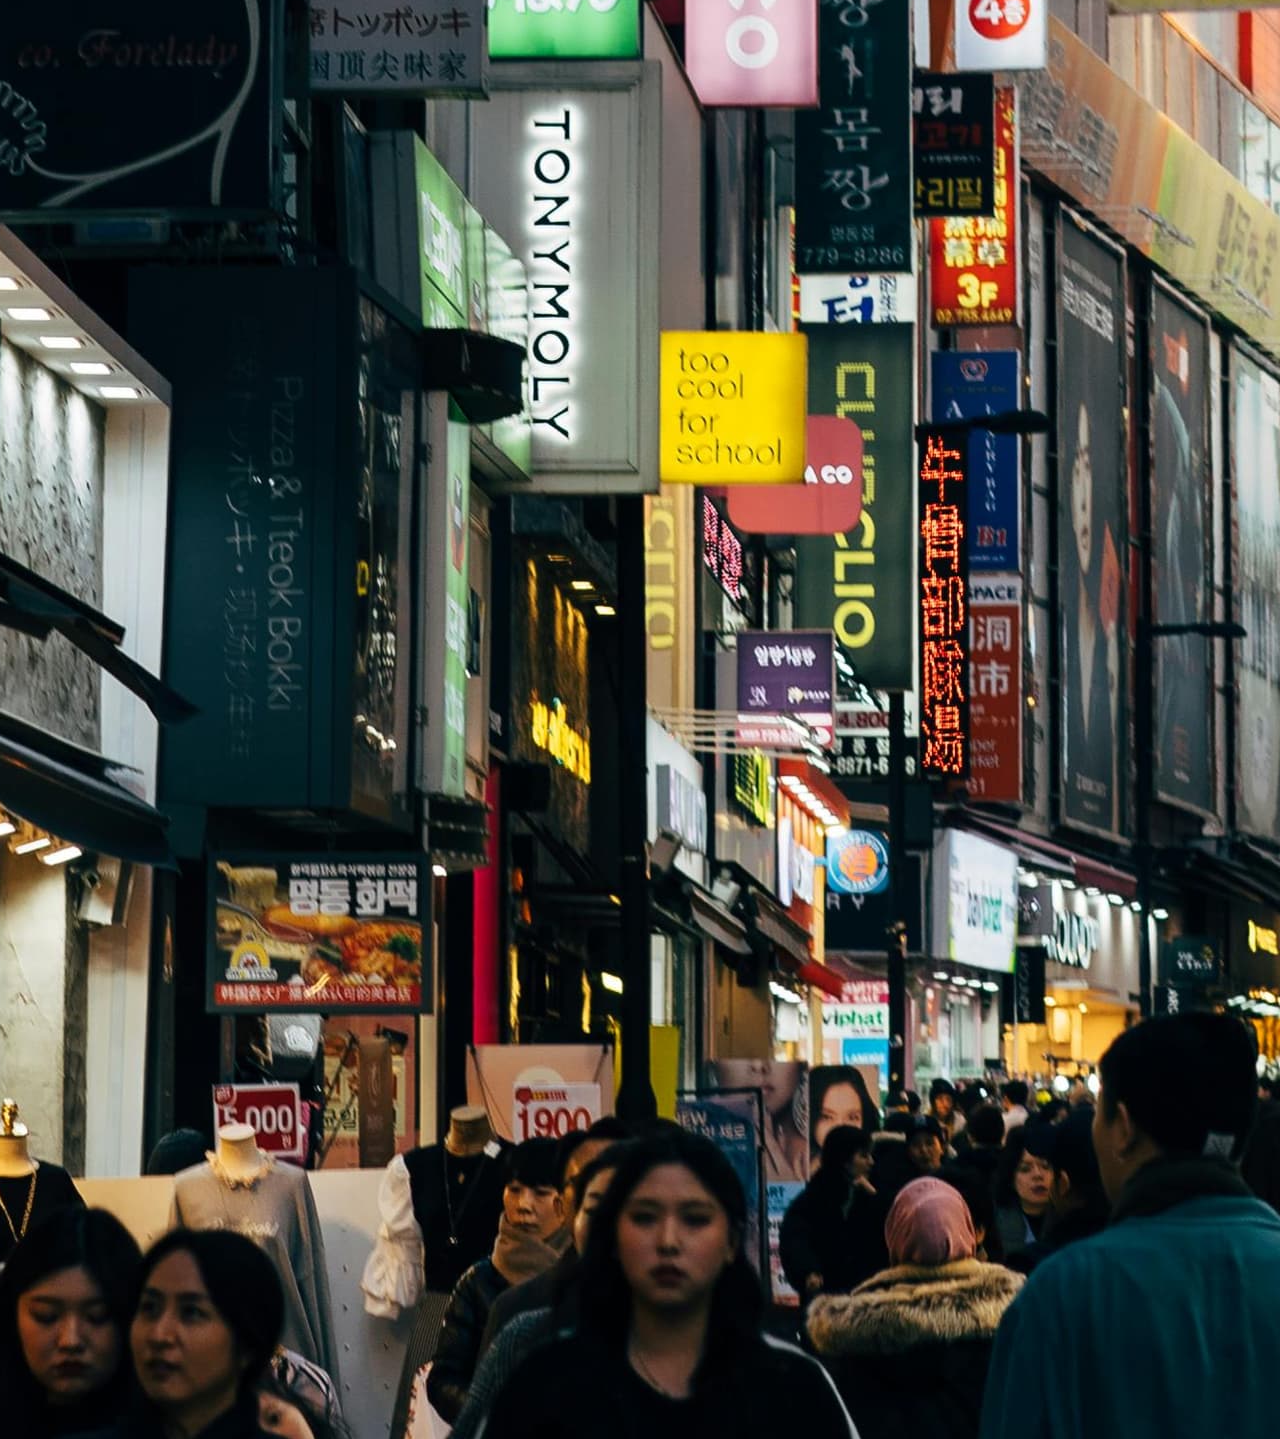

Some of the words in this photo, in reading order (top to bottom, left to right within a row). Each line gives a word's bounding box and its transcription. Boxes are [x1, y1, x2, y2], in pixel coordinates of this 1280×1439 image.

[802, 244, 905, 266] 779-8286
[529, 105, 572, 442] TONYMOLY
[957, 273, 999, 309] 3F
[677, 348, 730, 374] too
[677, 374, 745, 401] cool
[677, 408, 719, 435] for
[676, 437, 783, 467] school
[289, 878, 352, 916] 명동
